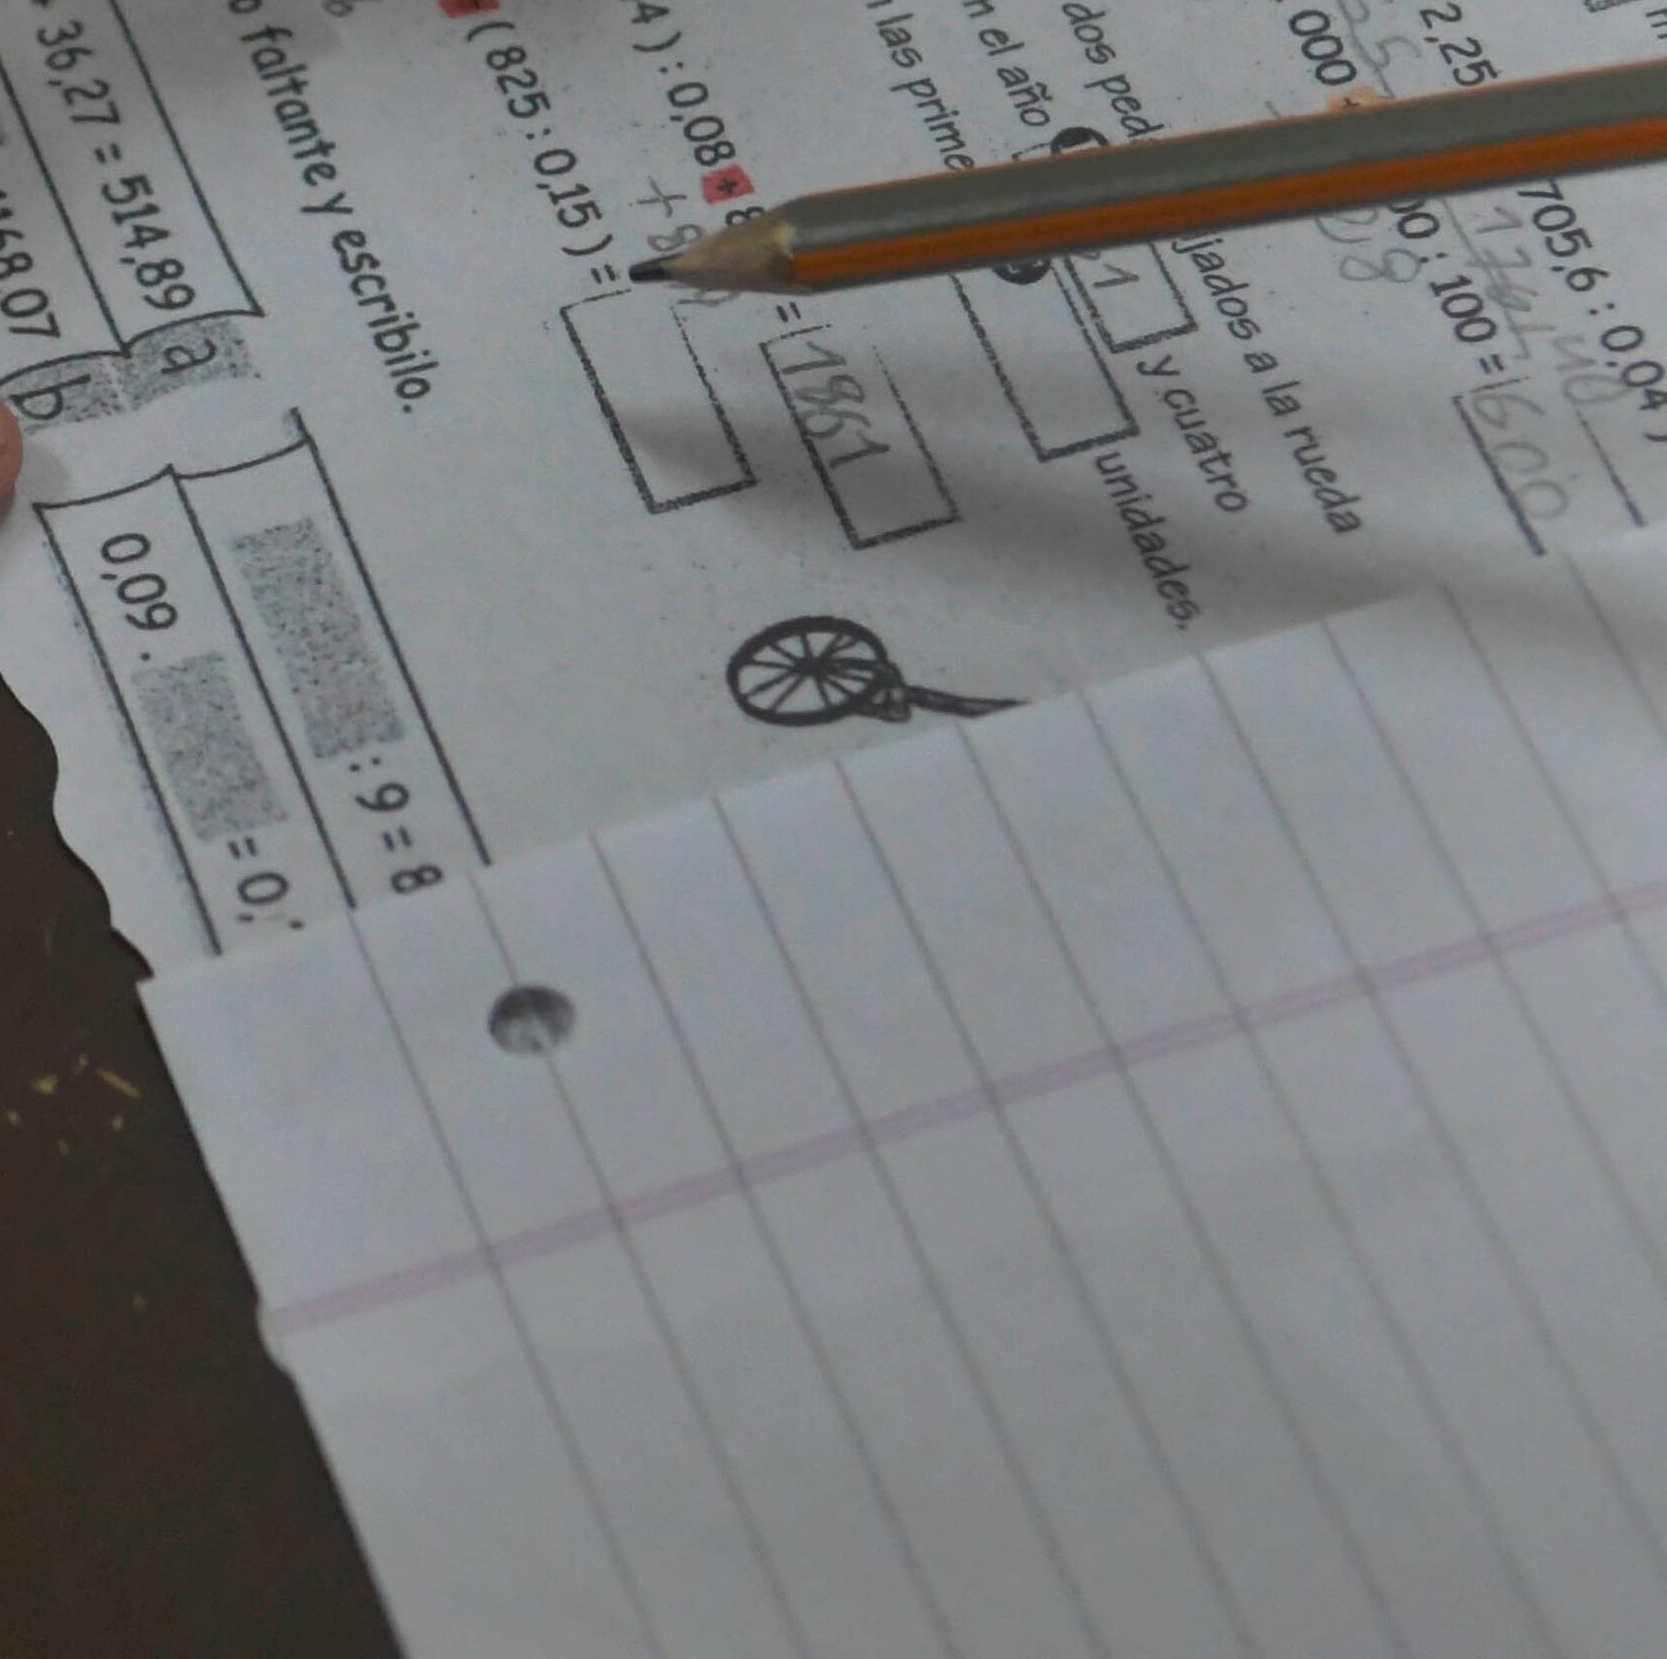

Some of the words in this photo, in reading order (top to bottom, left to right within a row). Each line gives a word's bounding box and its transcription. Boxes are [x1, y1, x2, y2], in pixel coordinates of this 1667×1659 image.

[874, 12, 923, 69] las
[977, 27, 1025, 57] el
[1060, 1, 1117, 65] dos
[665, 80, 736, 167] 0,08
[995, 65, 1053, 128] año
[35, 19, 121, 125] 36,27
[99, 172, 196, 311] 514,89
[532, 147, 603, 229] 0,15
[236, 21, 337, 187] faltante
[299, 190, 354, 215] y
[330, 228, 439, 414] escribilo.
[1427, 273, 1498, 344] 100
[1242, 351, 1279, 374] a
[1134, 353, 1181, 377] y
[1160, 387, 1248, 513] cuatro
[1260, 379, 1302, 418] la
[1281, 424, 1363, 535] rueda
[1094, 451, 1200, 630] unidades.
[99, 531, 178, 631] 0,09
[353, 781, 410, 813] 9
[235, 869, 304, 930] 0,
